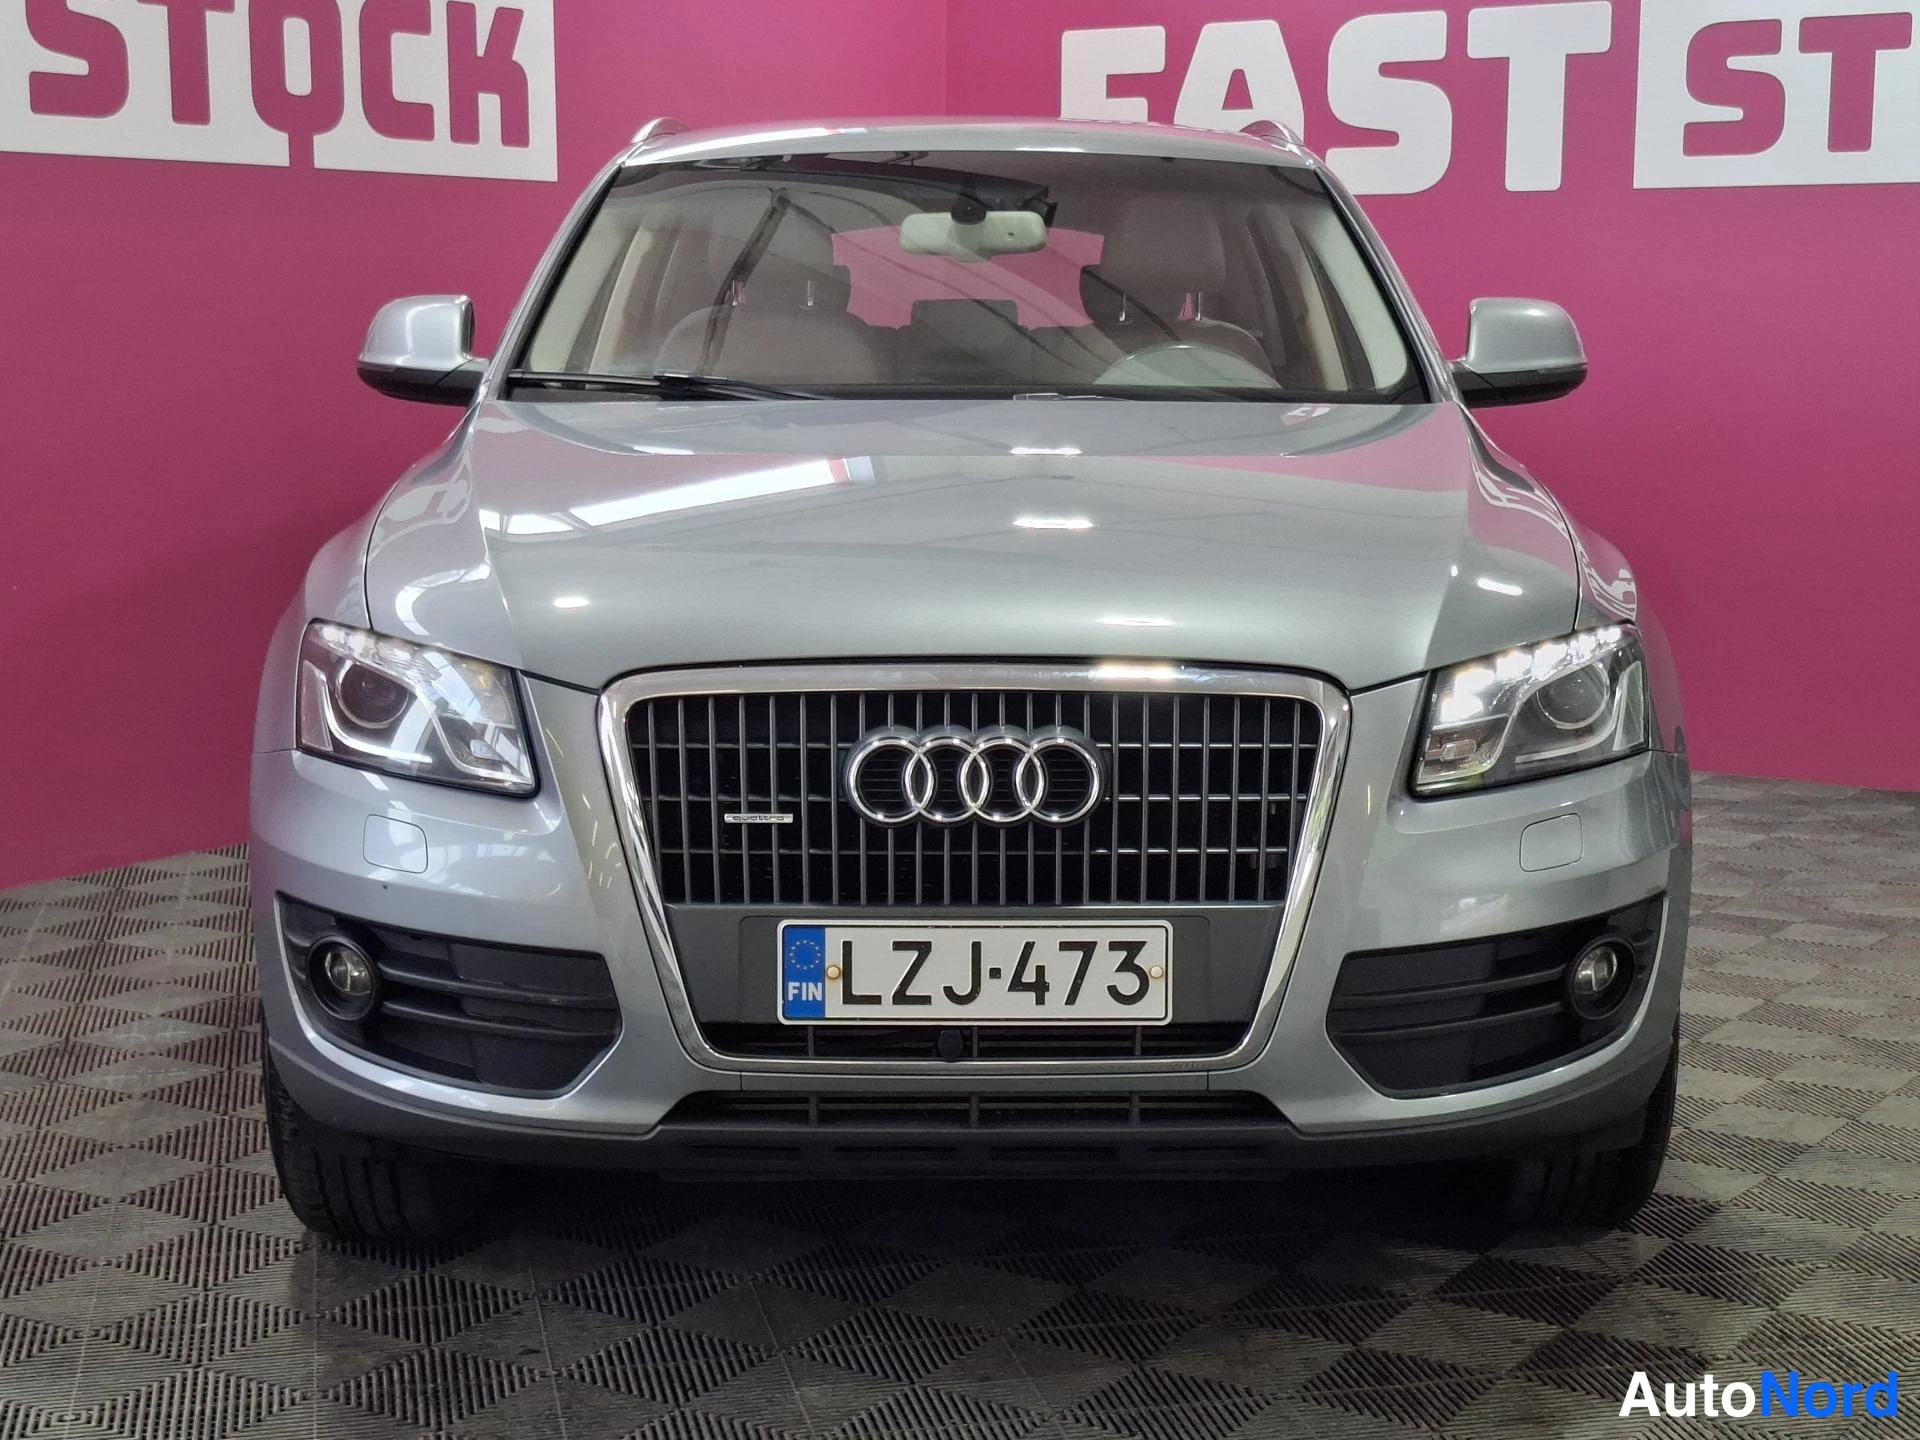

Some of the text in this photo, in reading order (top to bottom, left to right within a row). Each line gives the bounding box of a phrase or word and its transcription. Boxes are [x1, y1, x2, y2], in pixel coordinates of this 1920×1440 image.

[1060, 1, 1912, 196] FAST ST
[787, 981, 822, 1002] FIN
